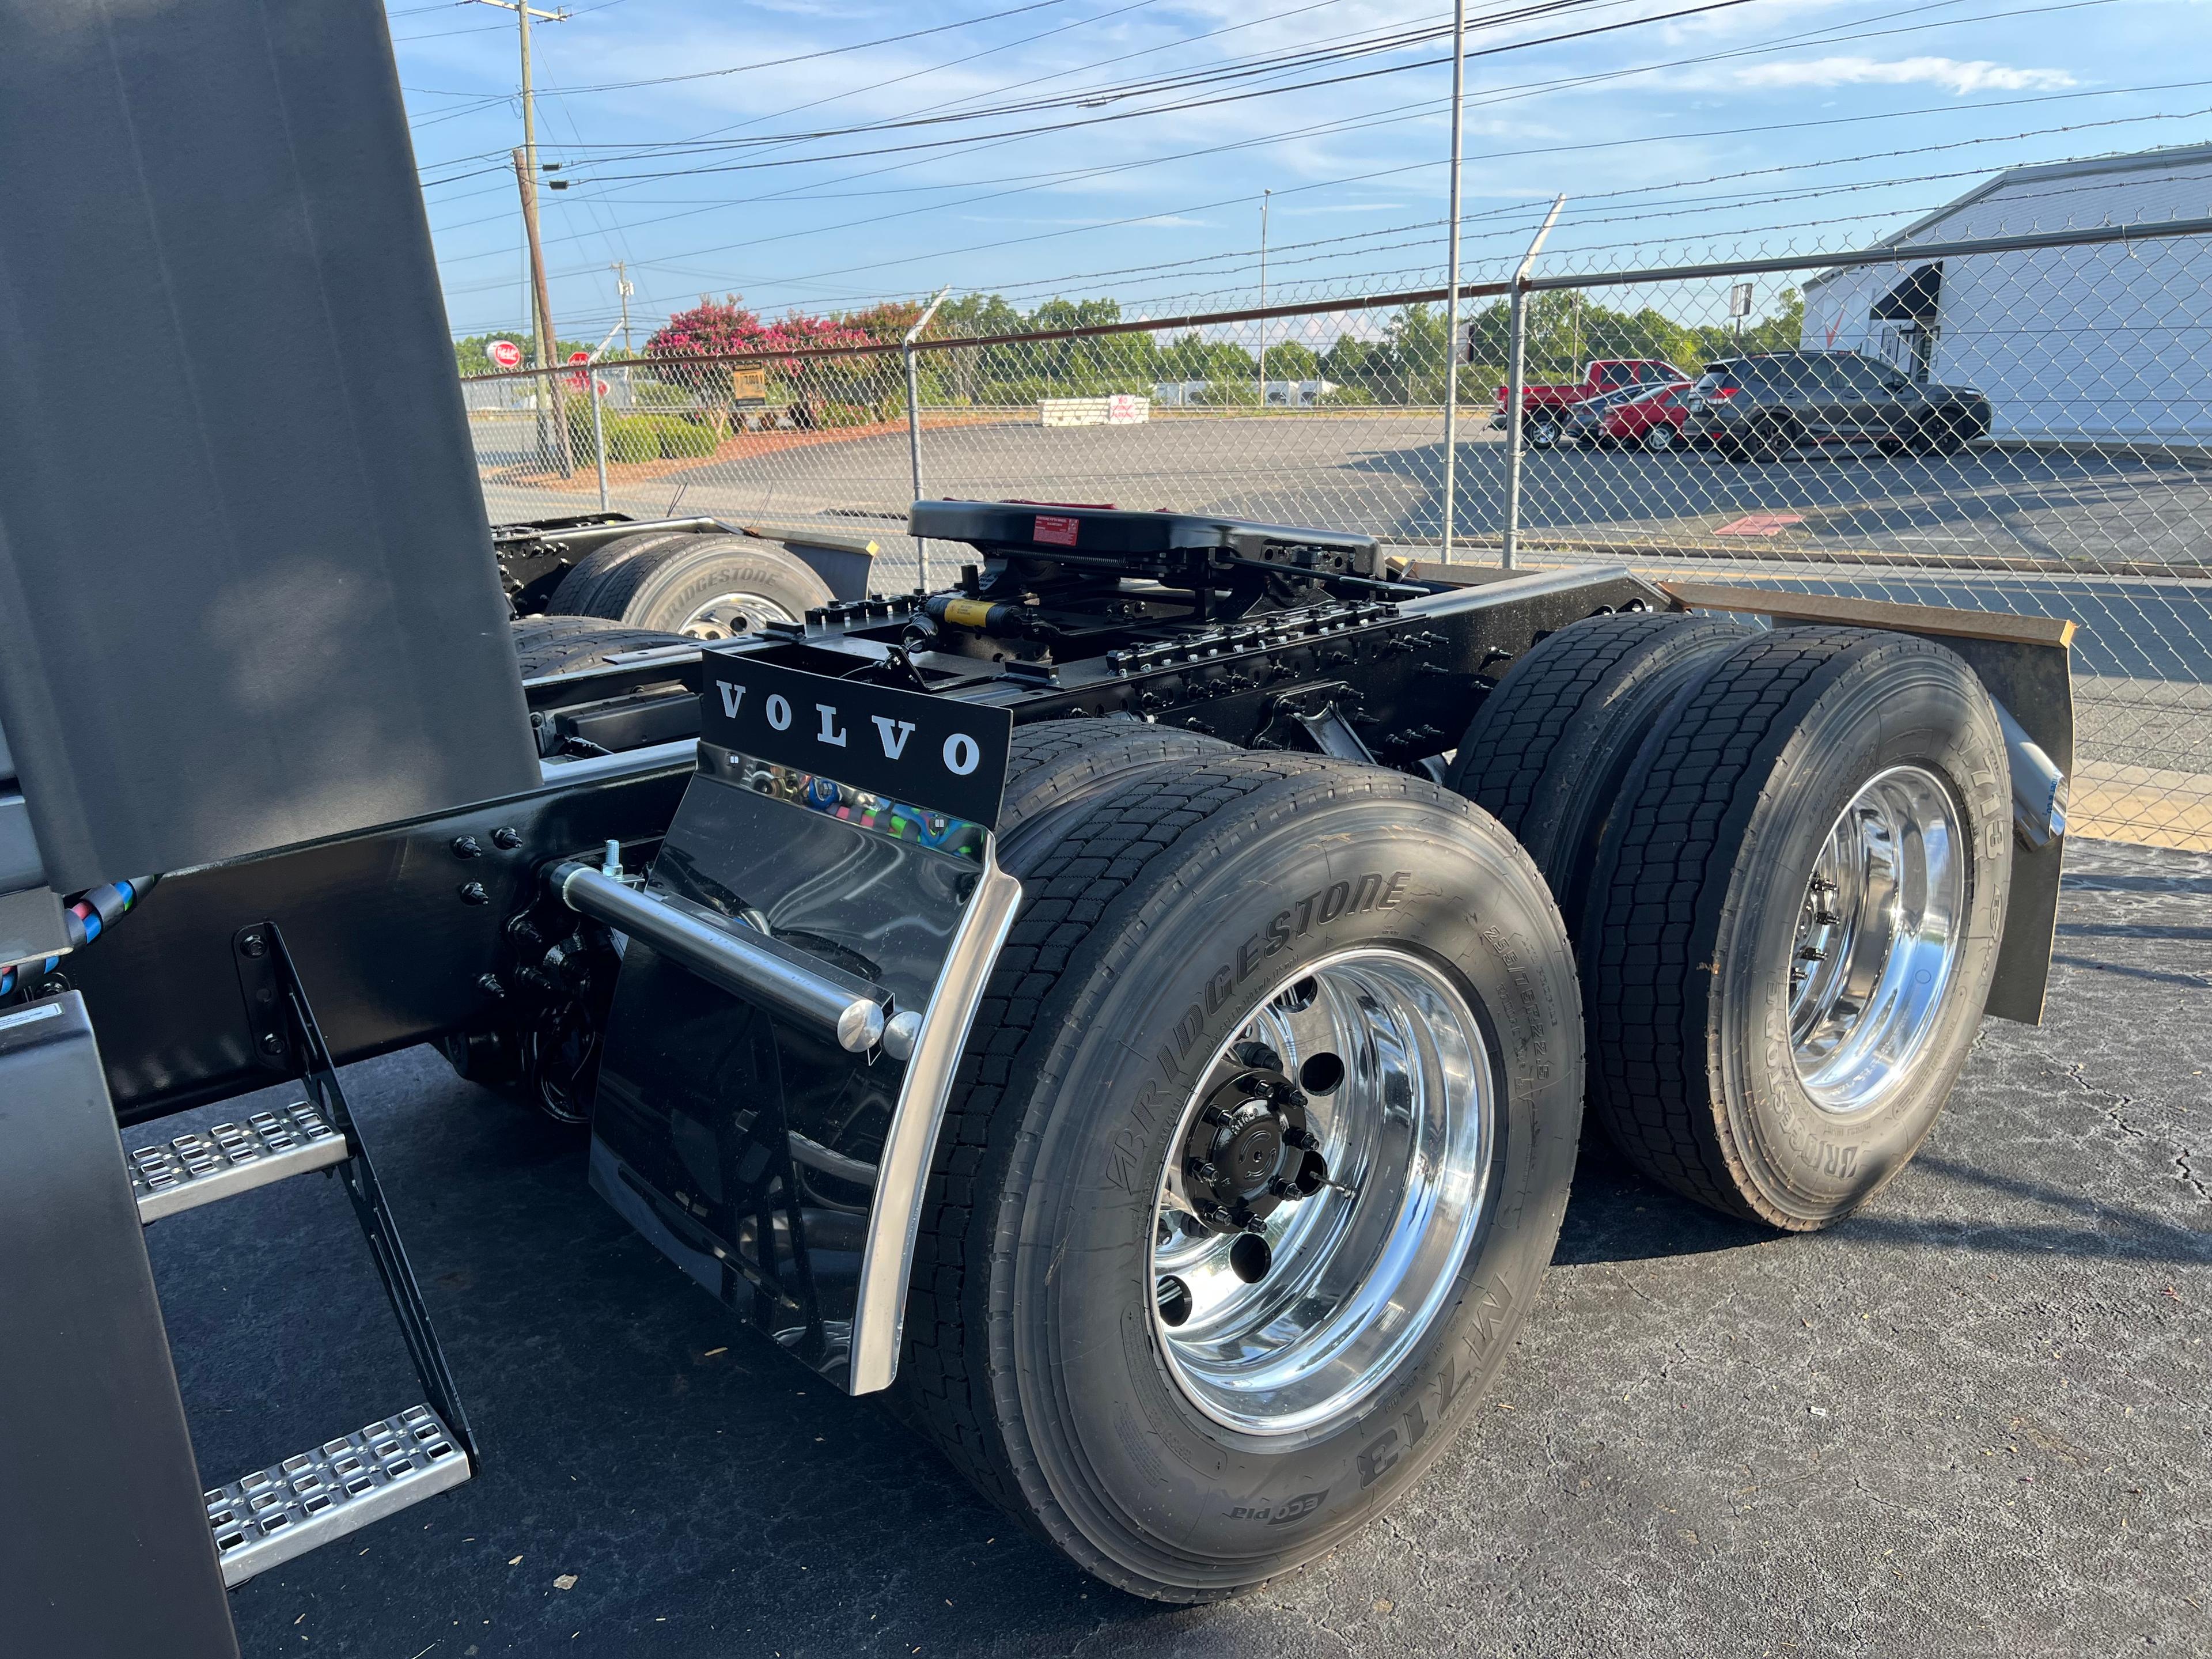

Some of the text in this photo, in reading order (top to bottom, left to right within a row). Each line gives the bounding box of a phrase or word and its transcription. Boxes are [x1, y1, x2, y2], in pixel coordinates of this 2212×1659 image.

[654, 567, 781, 631] BRIDGESTONE
[716, 680, 980, 775] VOLVO
[1949, 719, 2004, 862] M713
[1106, 870, 1411, 1196] BRIDGESTONE
[1219, 1003, 1243, 1032] SPEED
[1483, 925, 1550, 1080] 295/75R22.5
[1765, 979, 1859, 1179] BRIDGESTONE
[1357, 1271, 1514, 1492] M713
